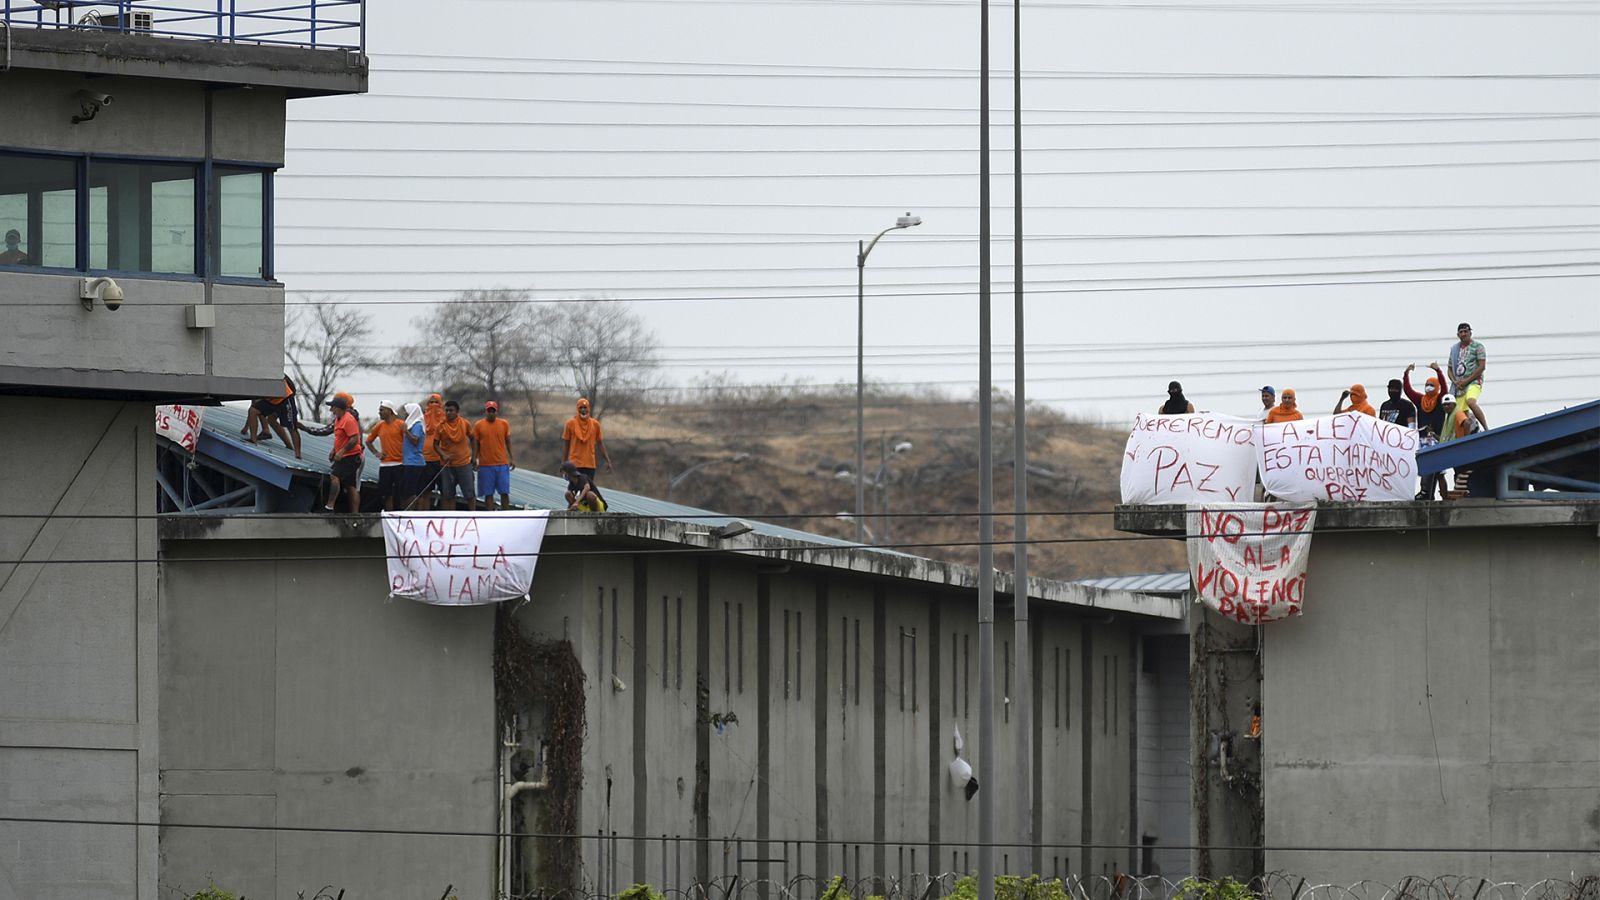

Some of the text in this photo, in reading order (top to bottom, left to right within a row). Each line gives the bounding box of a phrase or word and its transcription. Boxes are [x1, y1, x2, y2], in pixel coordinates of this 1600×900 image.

[1132, 414, 1255, 447] QUEREREMO
[1371, 420, 1416, 451] NOS
[1147, 445, 1220, 496] PAZ
[1263, 443, 1411, 478] ESTA MATANDO
[1325, 482, 1368, 502] PAZ
[1200, 505, 1313, 544] NO PAZ
[396, 539, 511, 572] VARELA
